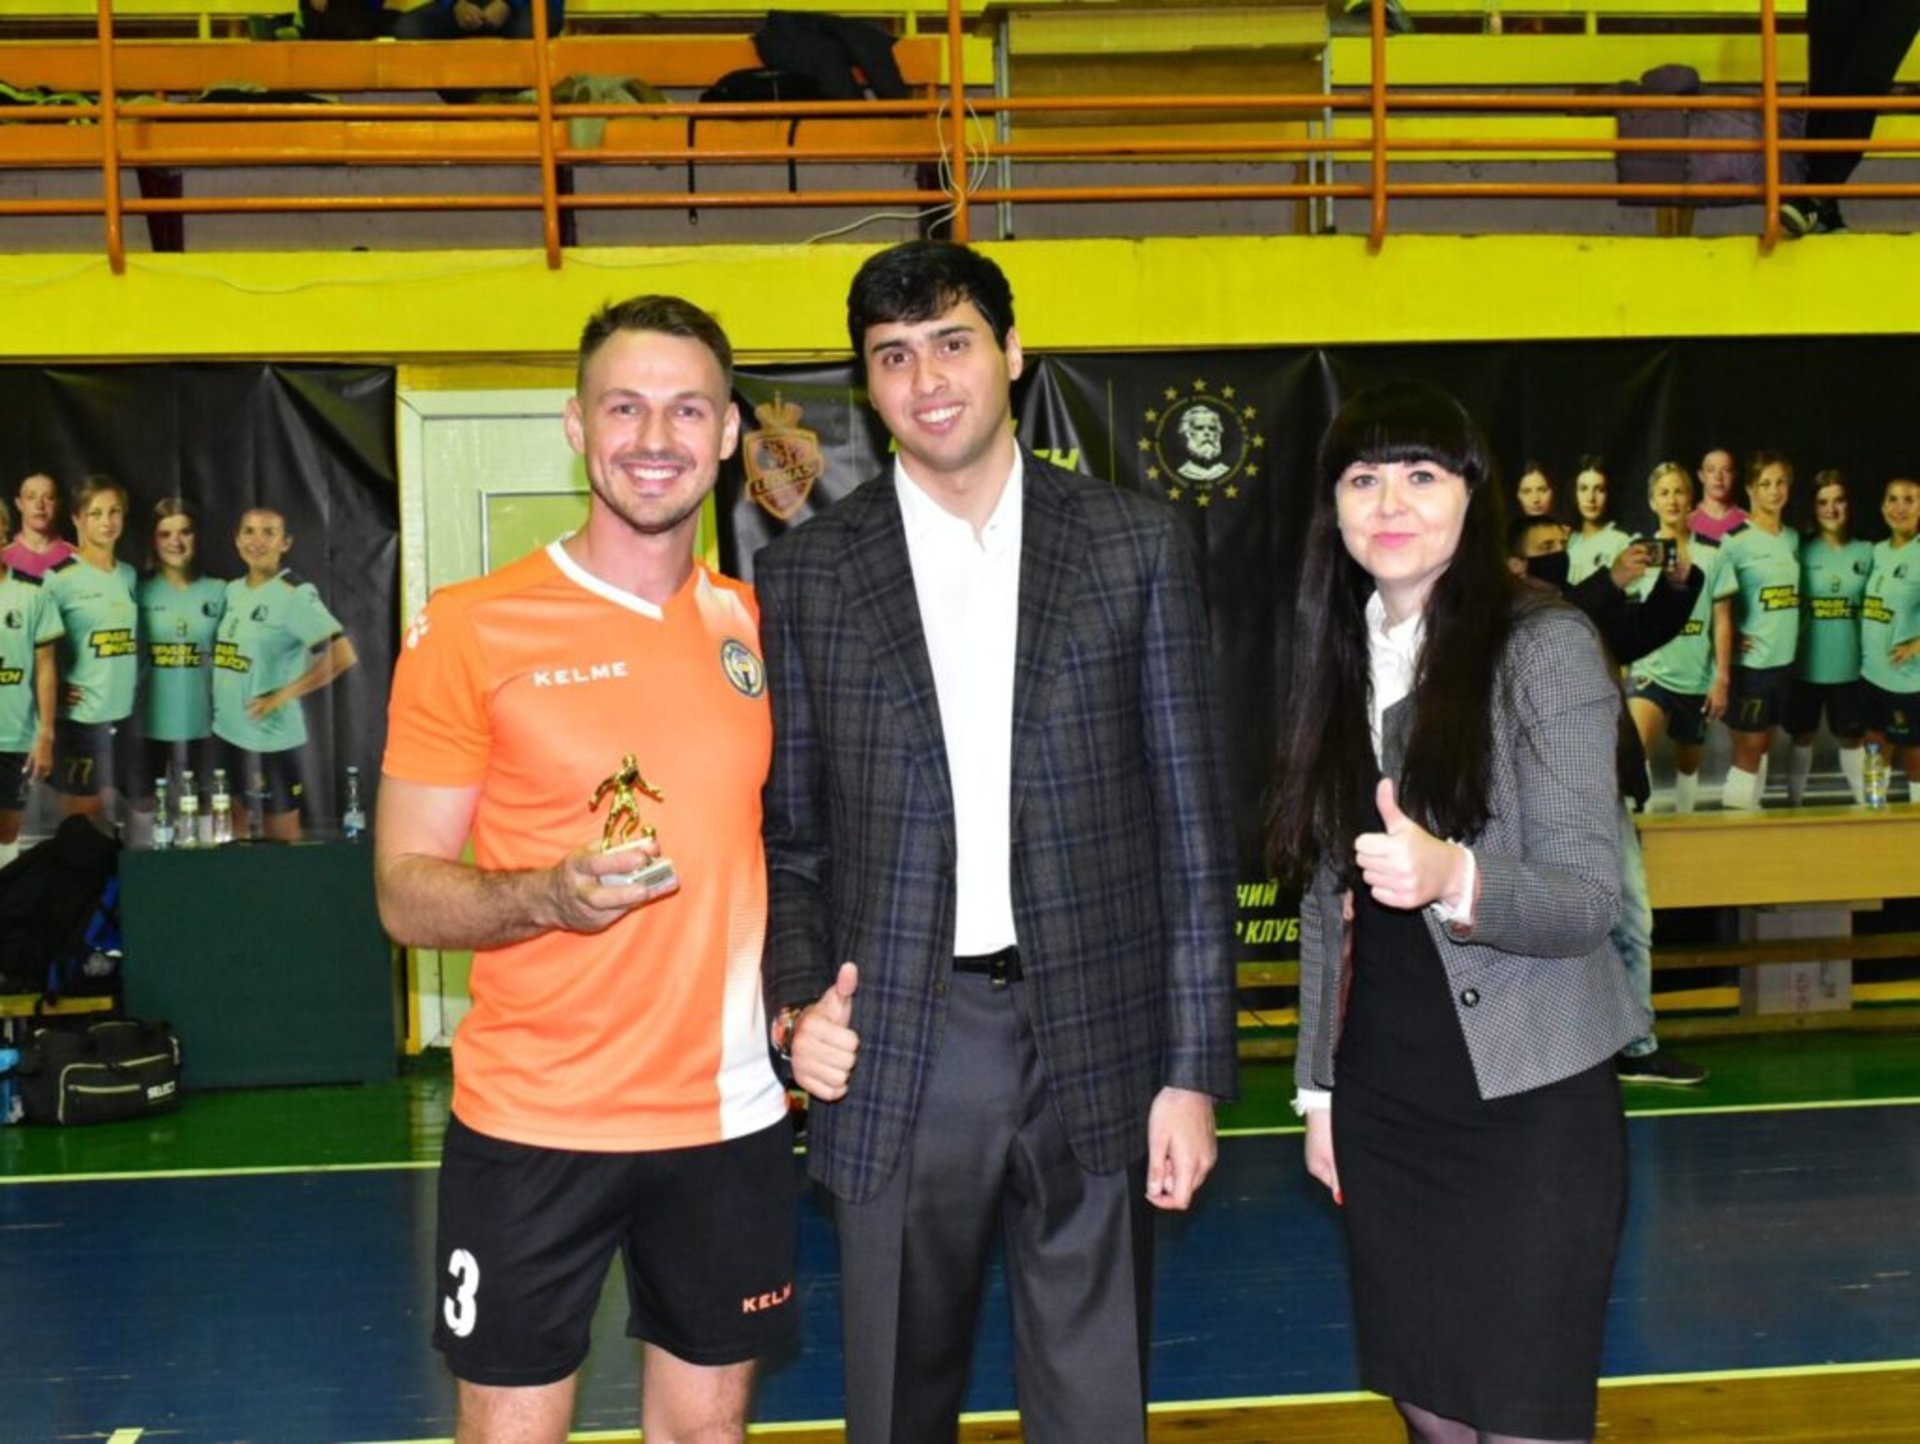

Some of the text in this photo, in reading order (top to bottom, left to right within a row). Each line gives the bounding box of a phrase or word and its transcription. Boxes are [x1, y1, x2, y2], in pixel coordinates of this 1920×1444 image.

[532, 661, 629, 687] KELME
[1244, 918, 1300, 944] КЛУБ
[444, 1248, 480, 1338] 3
